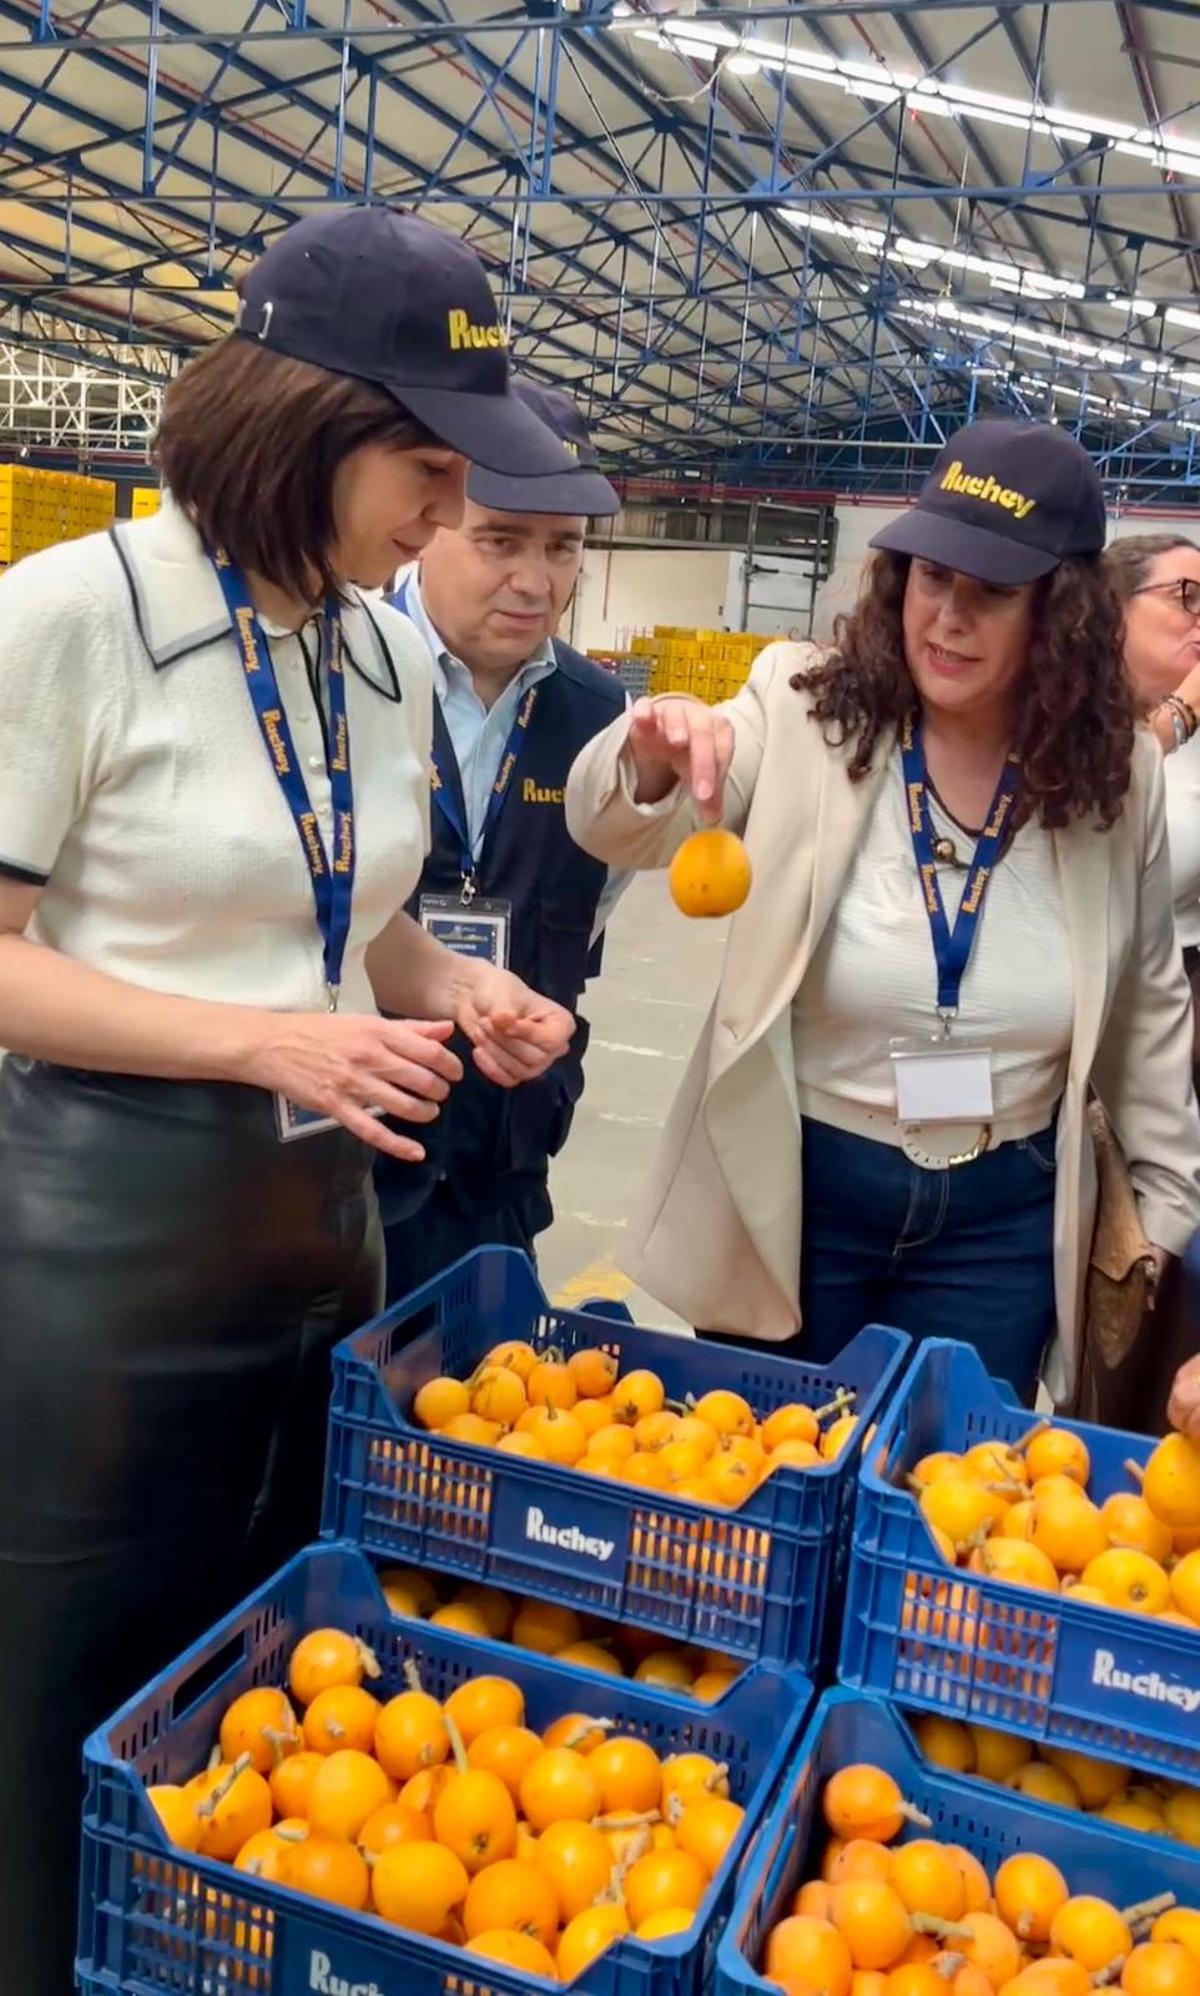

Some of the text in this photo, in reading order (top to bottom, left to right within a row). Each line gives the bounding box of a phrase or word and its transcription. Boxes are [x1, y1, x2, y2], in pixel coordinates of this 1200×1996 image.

[940, 460, 1035, 518] Ruchey
[235, 607, 260, 673] Ruchey
[262, 710, 290, 776] Ruchey
[526, 1505, 615, 1561] Ruchey
[1092, 1649, 1200, 1712] Ruchey
